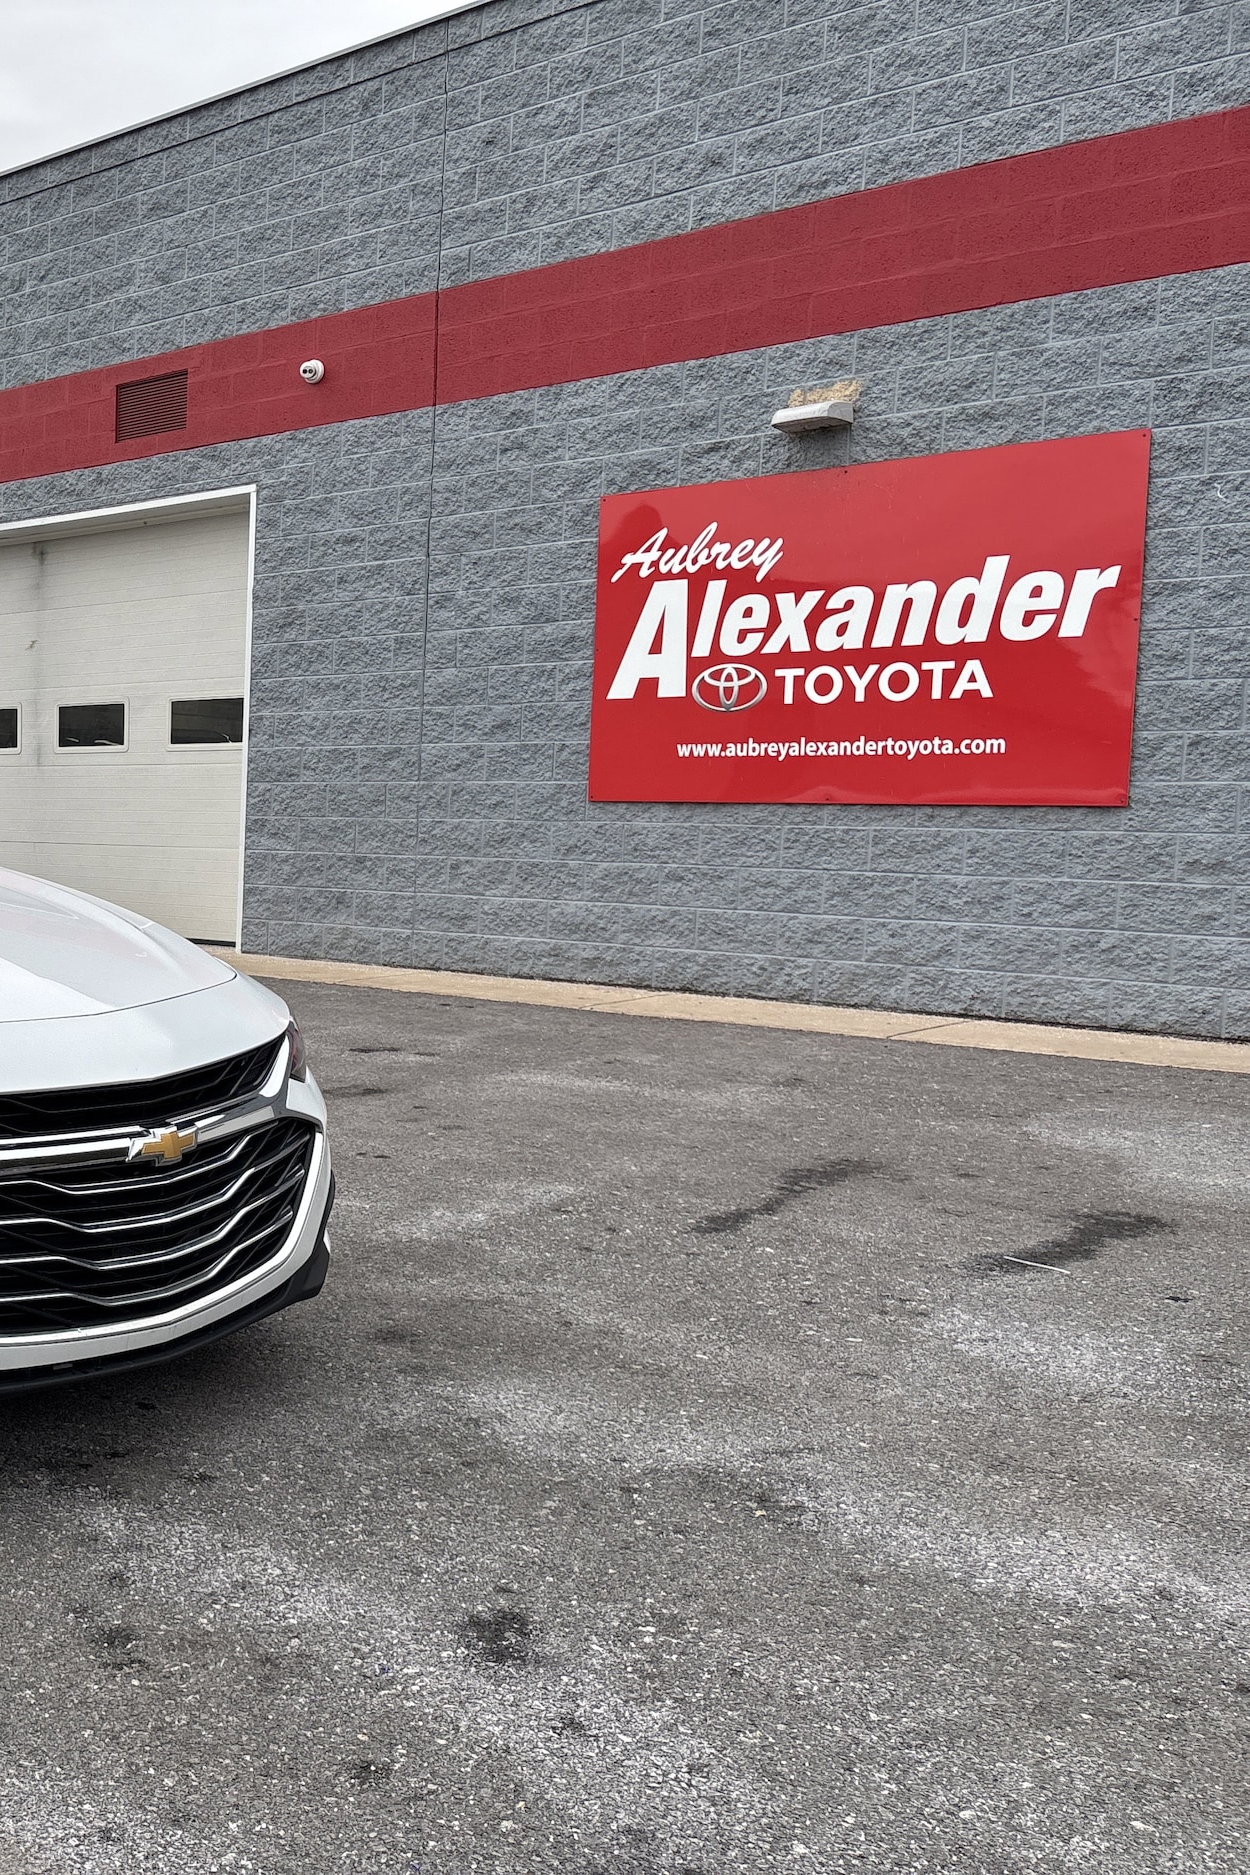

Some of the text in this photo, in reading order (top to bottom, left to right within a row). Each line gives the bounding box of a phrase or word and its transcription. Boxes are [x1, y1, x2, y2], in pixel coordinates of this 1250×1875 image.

[611, 521, 784, 583] Aubrey
[606, 555, 1122, 700] Alexander
[774, 659, 994, 705] TOYOTA
[677, 736, 1006, 762] www.aubreyalexandertoyota.com
